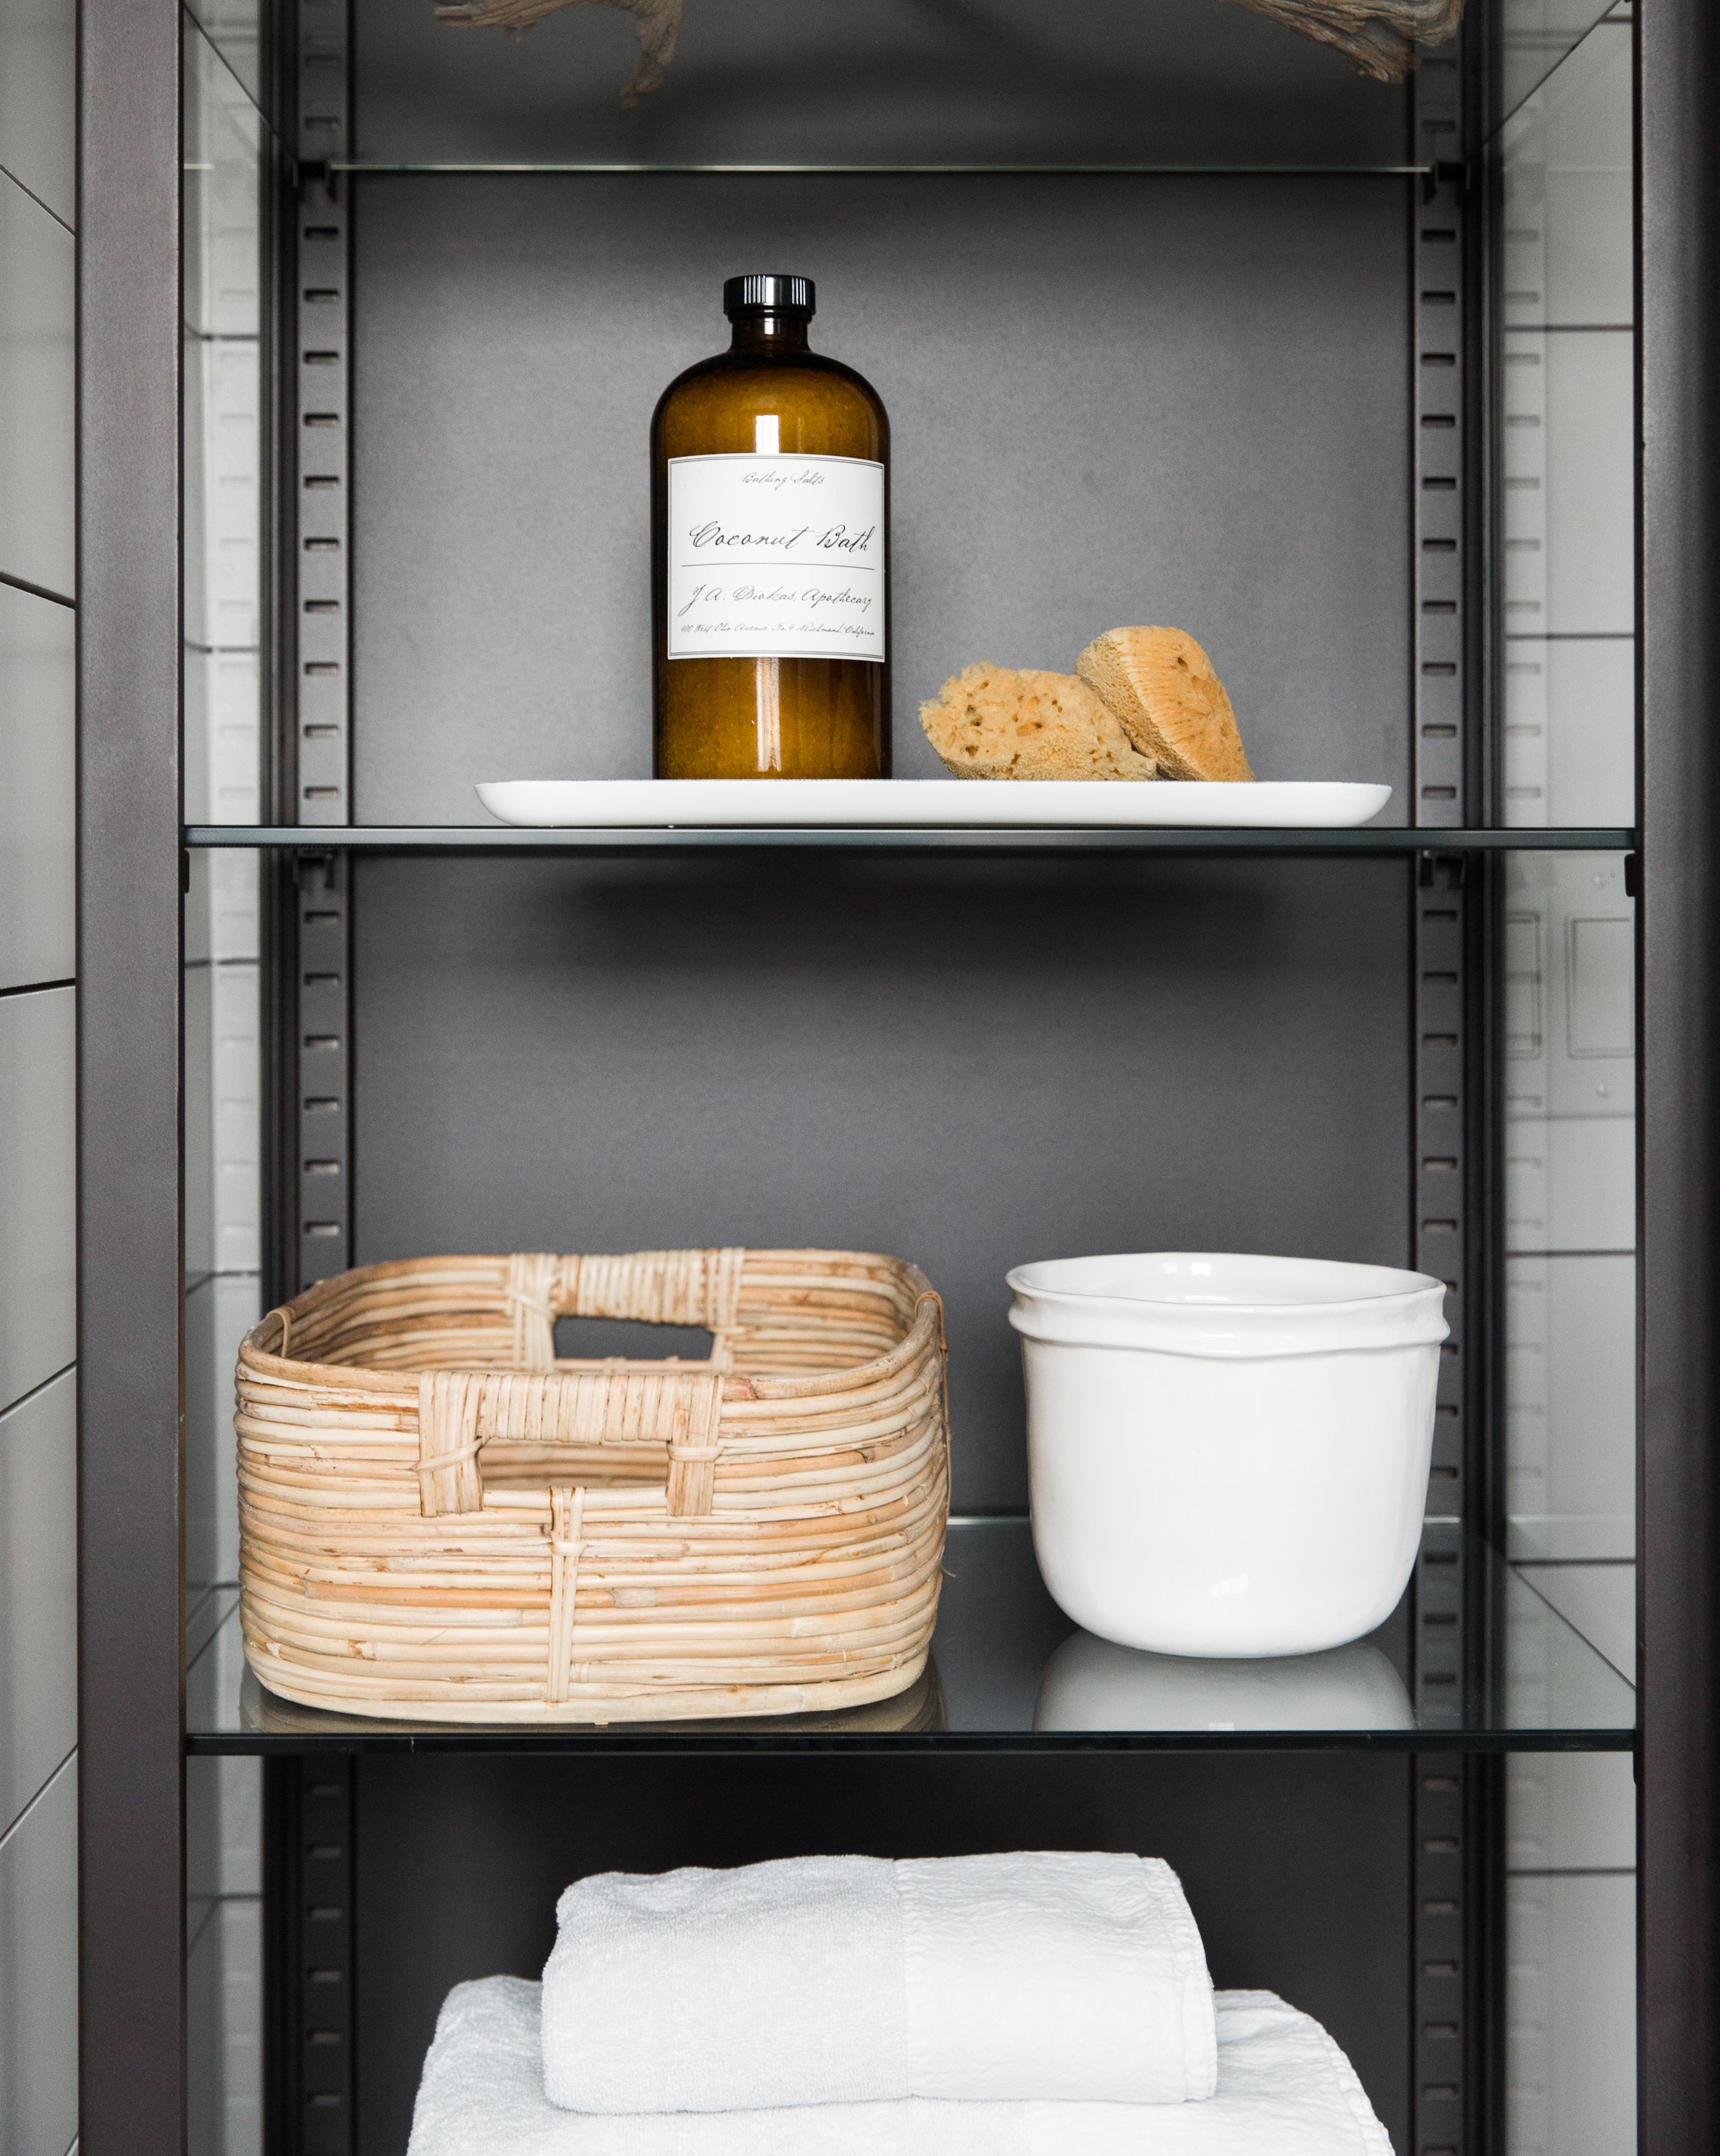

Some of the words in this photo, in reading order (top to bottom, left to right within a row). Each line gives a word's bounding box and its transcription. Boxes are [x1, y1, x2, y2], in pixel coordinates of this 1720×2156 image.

[742, 470, 788, 491] Bathing
[790, 469, 825, 485] Salts
[689, 521, 815, 550] Coconut
[816, 524, 876, 553] Bath
[801, 588, 872, 613] Apothecary
